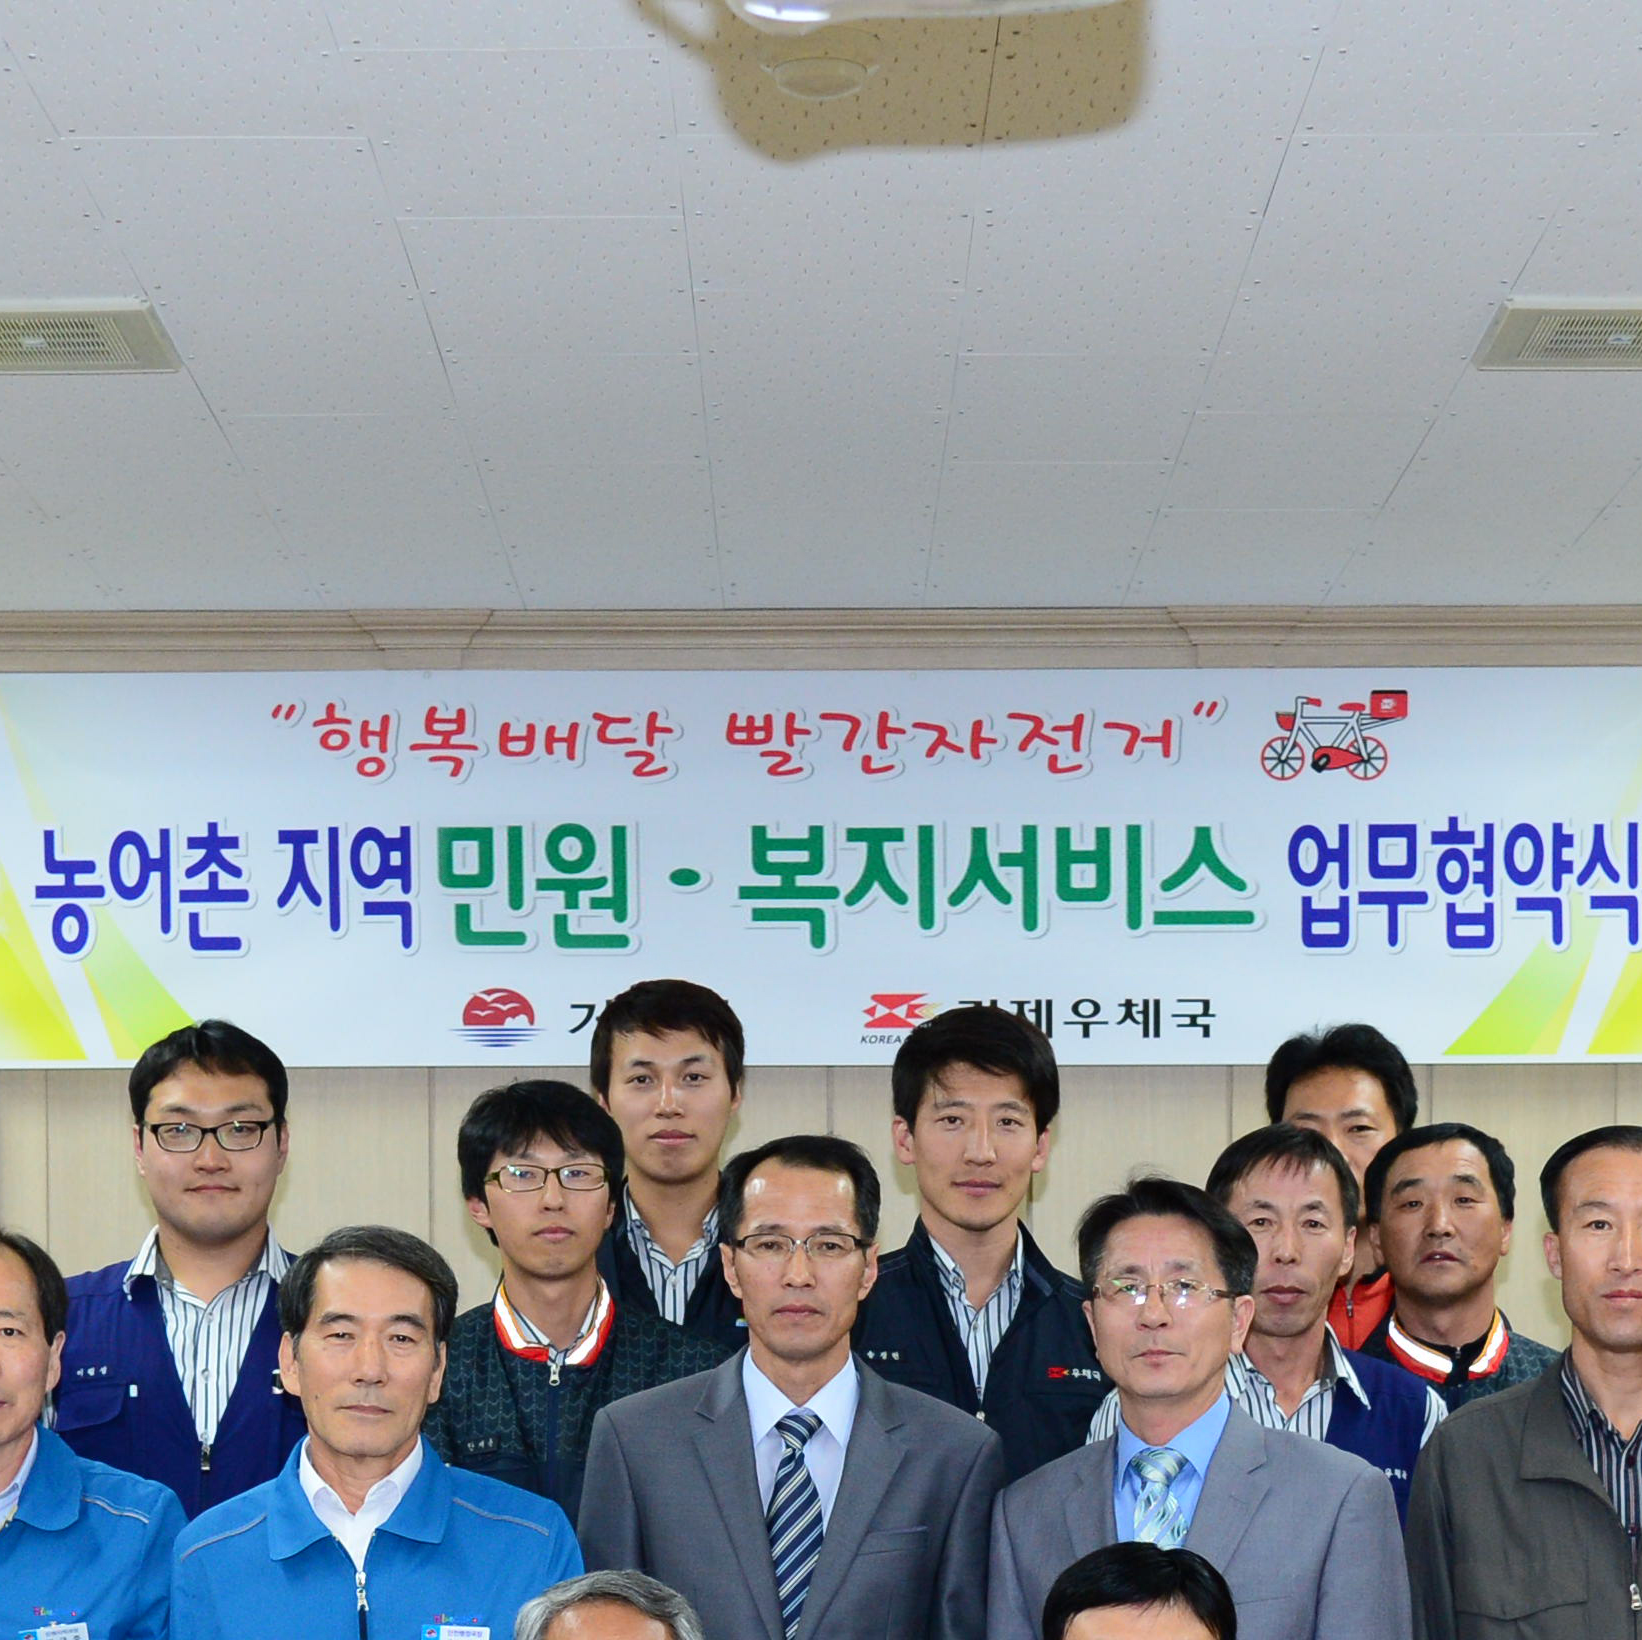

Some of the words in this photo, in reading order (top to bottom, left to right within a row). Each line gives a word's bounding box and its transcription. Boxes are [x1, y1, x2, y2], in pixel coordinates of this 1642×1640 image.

[34, 821, 251, 956] 농어촌
[277, 825, 414, 950] 지역
[438, 823, 631, 949] 민원
[738, 822, 1256, 950] 복지서비스
[1287, 815, 1640, 950] 업무협약식
[957, 997, 1217, 1039] 제우체국
[860, 1034, 902, 1045] KOREA
